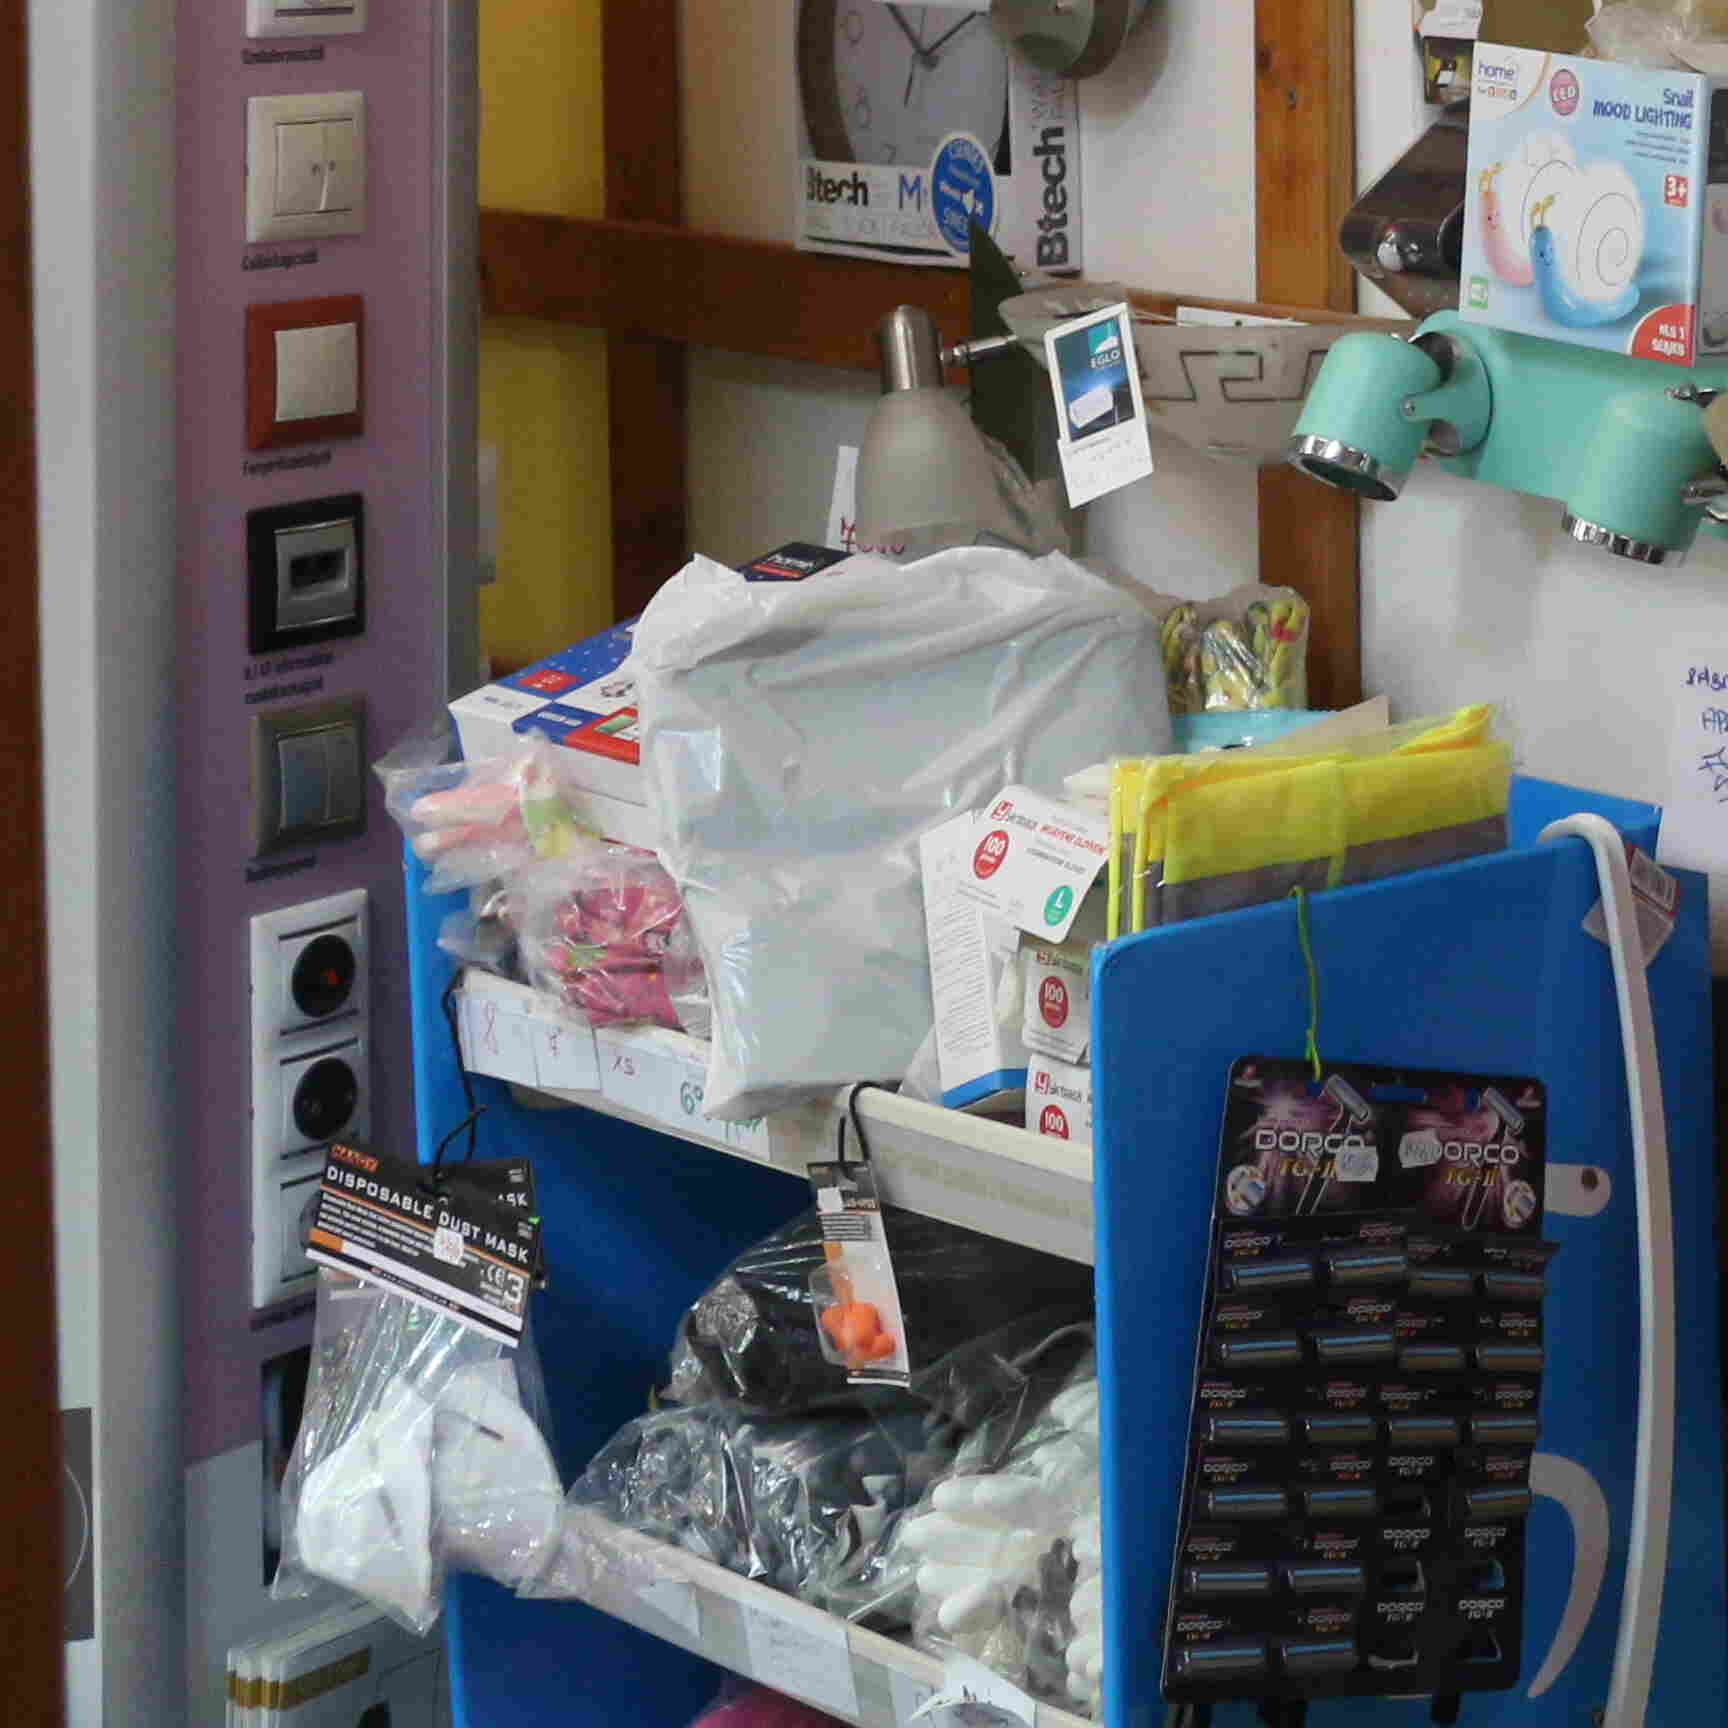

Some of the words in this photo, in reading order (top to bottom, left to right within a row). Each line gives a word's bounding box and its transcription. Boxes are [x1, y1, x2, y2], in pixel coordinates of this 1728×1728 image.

[1593, 100, 1632, 121] MOOD
[1634, 104, 1692, 129] LIGHTING
[1033, 127, 1069, 265] Btech
[1090, 348, 1121, 369] EGLO
[1043, 984, 1064, 1002] 100
[1438, 1142, 1520, 1167] ORCO
[327, 1166, 434, 1218] DISPOSABLE
[440, 1211, 480, 1240] DUST
[485, 1232, 530, 1264] MASK
